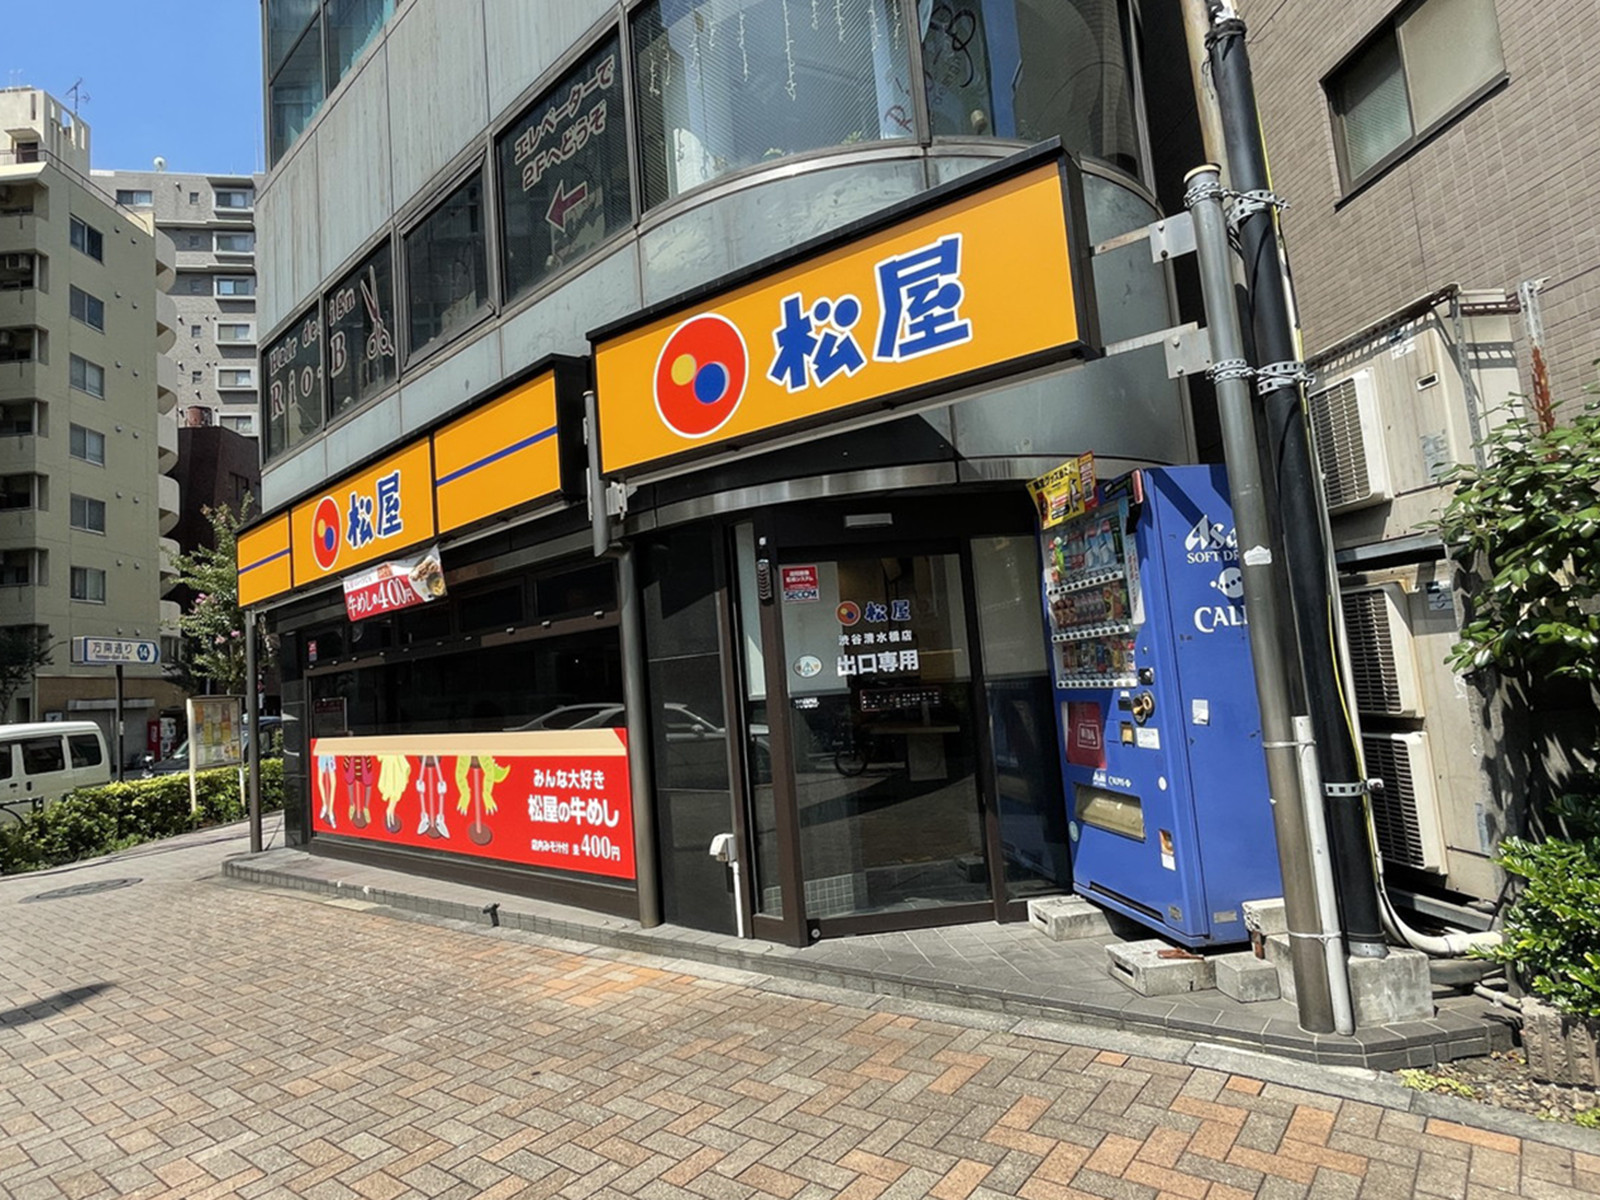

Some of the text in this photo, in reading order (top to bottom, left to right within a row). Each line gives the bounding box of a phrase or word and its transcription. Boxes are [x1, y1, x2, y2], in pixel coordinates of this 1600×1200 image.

[514, 54, 615, 166] エレベーターで
[522, 98, 607, 192] 2Fへどうぞ
[767, 233, 973, 393] 松屋
[346, 469, 404, 550] 松屋
[1187, 551, 1220, 564] SOFT
[785, 589, 817, 600] SECOM
[864, 600, 912, 623] 松屋
[837, 650, 919, 677] 出口専用
[533, 769, 605, 790] みんな大好き
[527, 794, 619, 828] 松屋の牛めし
